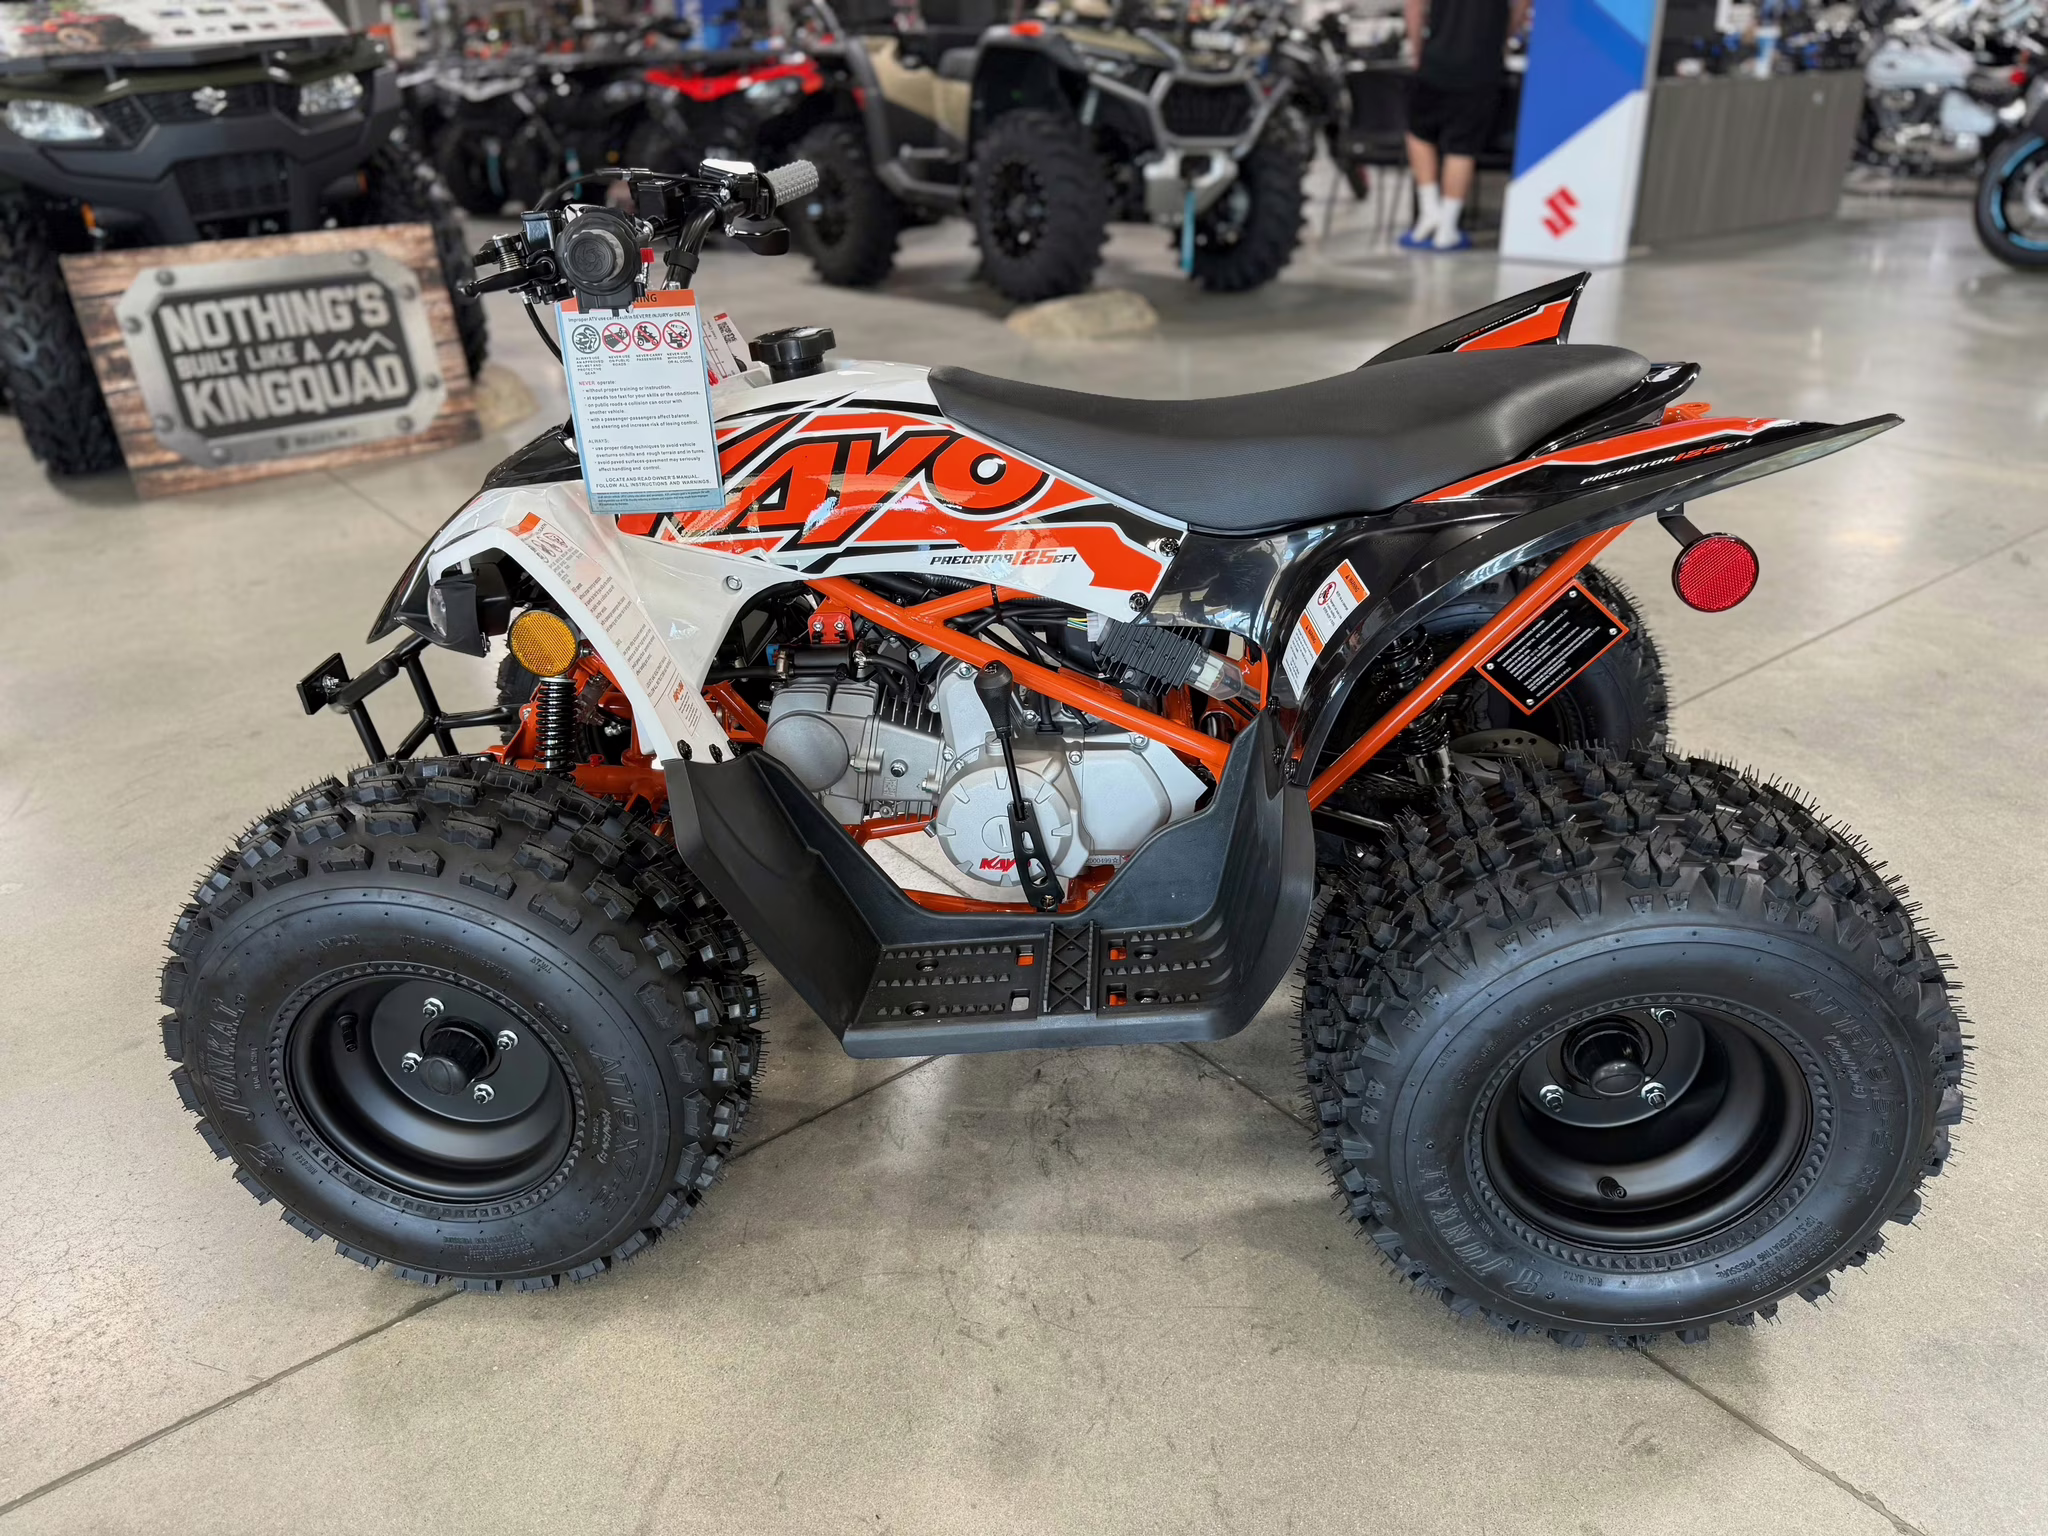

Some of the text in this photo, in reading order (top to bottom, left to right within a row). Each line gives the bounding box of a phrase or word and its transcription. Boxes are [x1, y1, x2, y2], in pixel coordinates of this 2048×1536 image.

[158, 283, 390, 352] NOTHING'S
[173, 339, 322, 381] BUILT LIKE A
[182, 354, 410, 429] KINGQUAD
[1462, 1192, 1479, 1210] CHINA
[1479, 1220, 1496, 1237] MADE
[1716, 1255, 1756, 1278] PRESSURE
